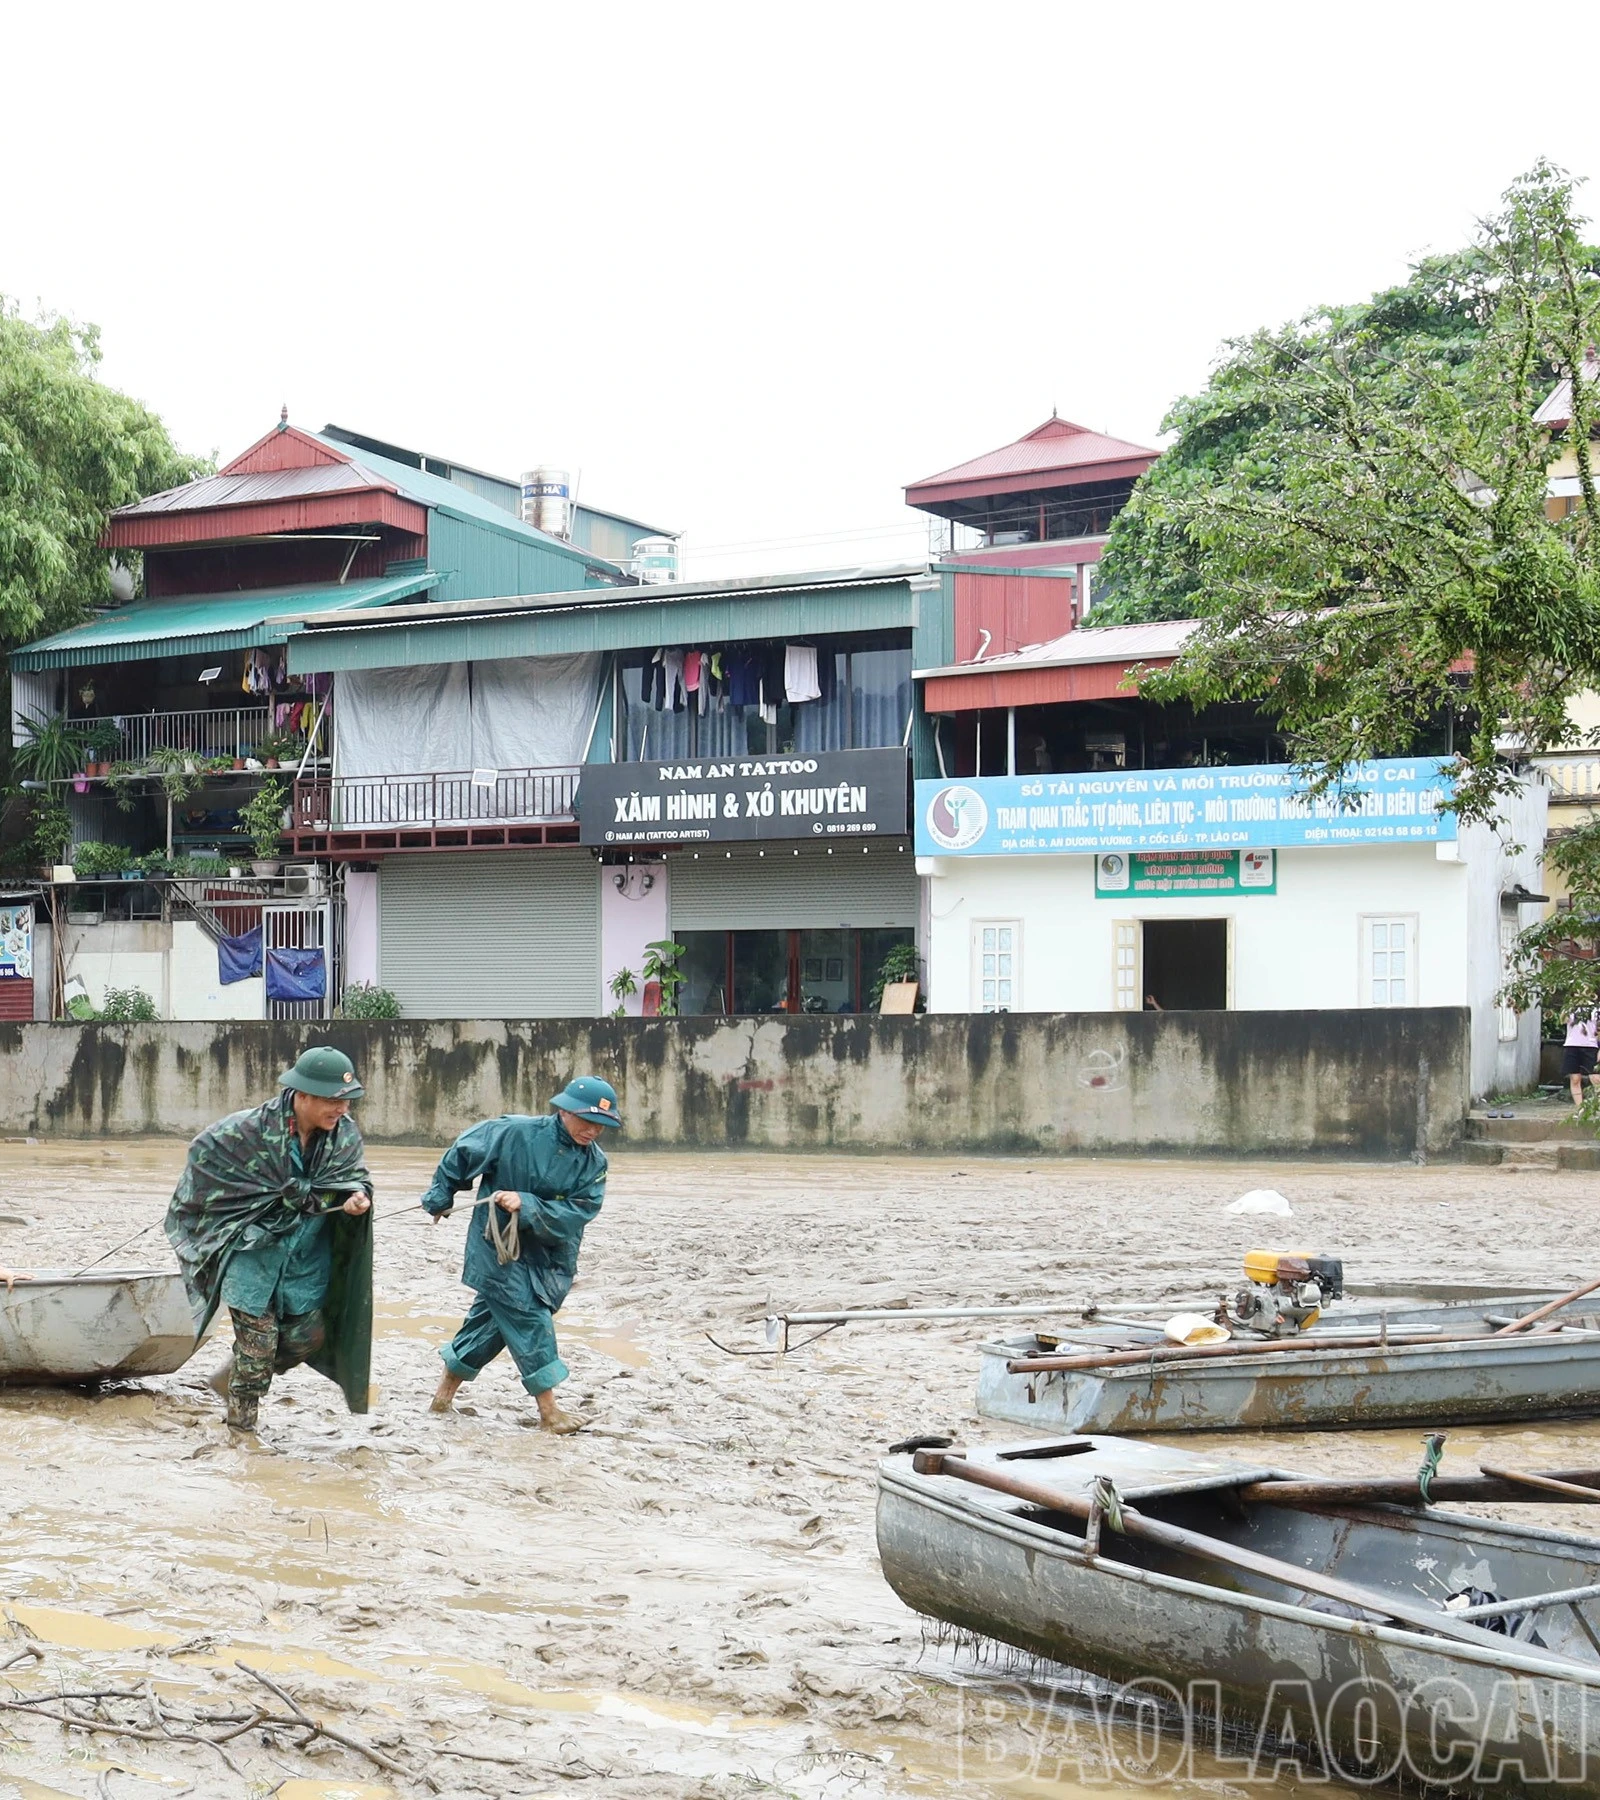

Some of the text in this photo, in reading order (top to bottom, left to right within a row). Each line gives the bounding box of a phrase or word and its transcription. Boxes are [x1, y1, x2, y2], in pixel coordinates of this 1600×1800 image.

[659, 759, 818, 781] NAM AN TATTOO
[1021, 780, 1043, 796] SỞ
[1047, 780, 1074, 796] TÀI
[1079, 778, 1148, 794] NGUYÊN
[1153, 776, 1177, 791] VÀ
[1181, 774, 1214, 790] MÔI
[1218, 772, 1292, 788] TRƯỜNG
[1384, 767, 1416, 781] CAI
[614, 781, 867, 823] XĂM HÌNH & XỎ KHUYÊN
[997, 807, 1027, 834] TRẠM
[1029, 805, 1059, 831] QUAN
[1061, 797, 1089, 828] TRẮC
[1092, 802, 1107, 832] TỰ
[1108, 799, 1142, 831] ĐỘNG,
[1144, 798, 1170, 825] LIÊN
[1172, 800, 1195, 829] TỤC
[1205, 795, 1228, 823] MÔI
[1231, 792, 1277, 822] TRƯỜNG
[1386, 787, 1415, 816] BIÊN
[615, 829, 710, 841] NAM AN (TATTOO ARTIST)
[826, 823, 877, 833] 0819 269 699
[1330, 828, 1362, 840] THOẠI:
[1364, 827, 1394, 837] 02143
[1396, 826, 1409, 836] 68
[1410, 826, 1424, 836] 68
[1426, 825, 1437, 835] 18
[1020, 835, 1037, 848] CHỈ:
[1050, 838, 1064, 847] AN
[1140, 836, 1147, 845] P.
[1149, 831, 1169, 844] CỐC
[1171, 830, 1188, 844] LẾU
[1195, 833, 1208, 843] TP.
[1211, 830, 1230, 842] LÀO
[1232, 832, 1249, 841] CAI
[1162, 865, 1177, 877] TỤC
[1178, 864, 1193, 875] MÔI
